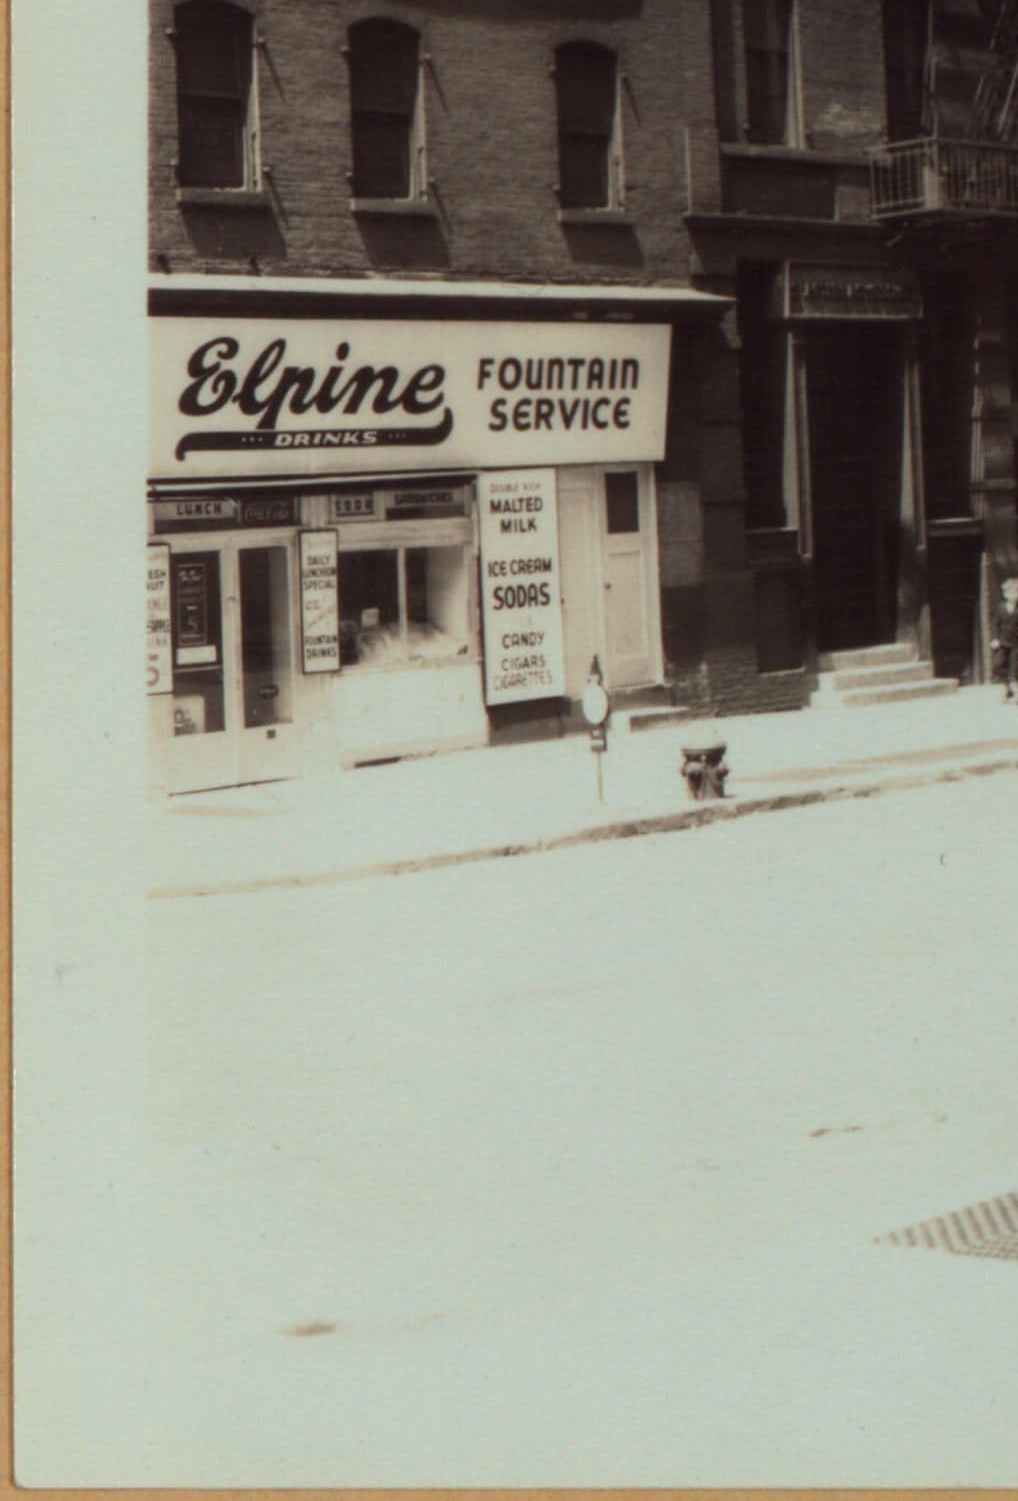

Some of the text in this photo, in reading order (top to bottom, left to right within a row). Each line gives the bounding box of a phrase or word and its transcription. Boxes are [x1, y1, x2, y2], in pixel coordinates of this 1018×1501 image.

[477, 357, 640, 391] FOUNTAIN
[178, 337, 446, 430] Elpine
[488, 397, 631, 433] SERVICE
[273, 430, 378, 448] DRINKS
[176, 502, 223, 517] LUNCH
[335, 500, 373, 514] SODA
[490, 497, 544, 514] MALTED
[500, 518, 537, 533] MILK
[488, 558, 552, 577] ICE CREAM
[493, 583, 550, 610] SODAS
[502, 632, 545, 650] CANDY
[501, 655, 546, 672] CIGARS
[494, 671, 553, 691] CIGARETTES
